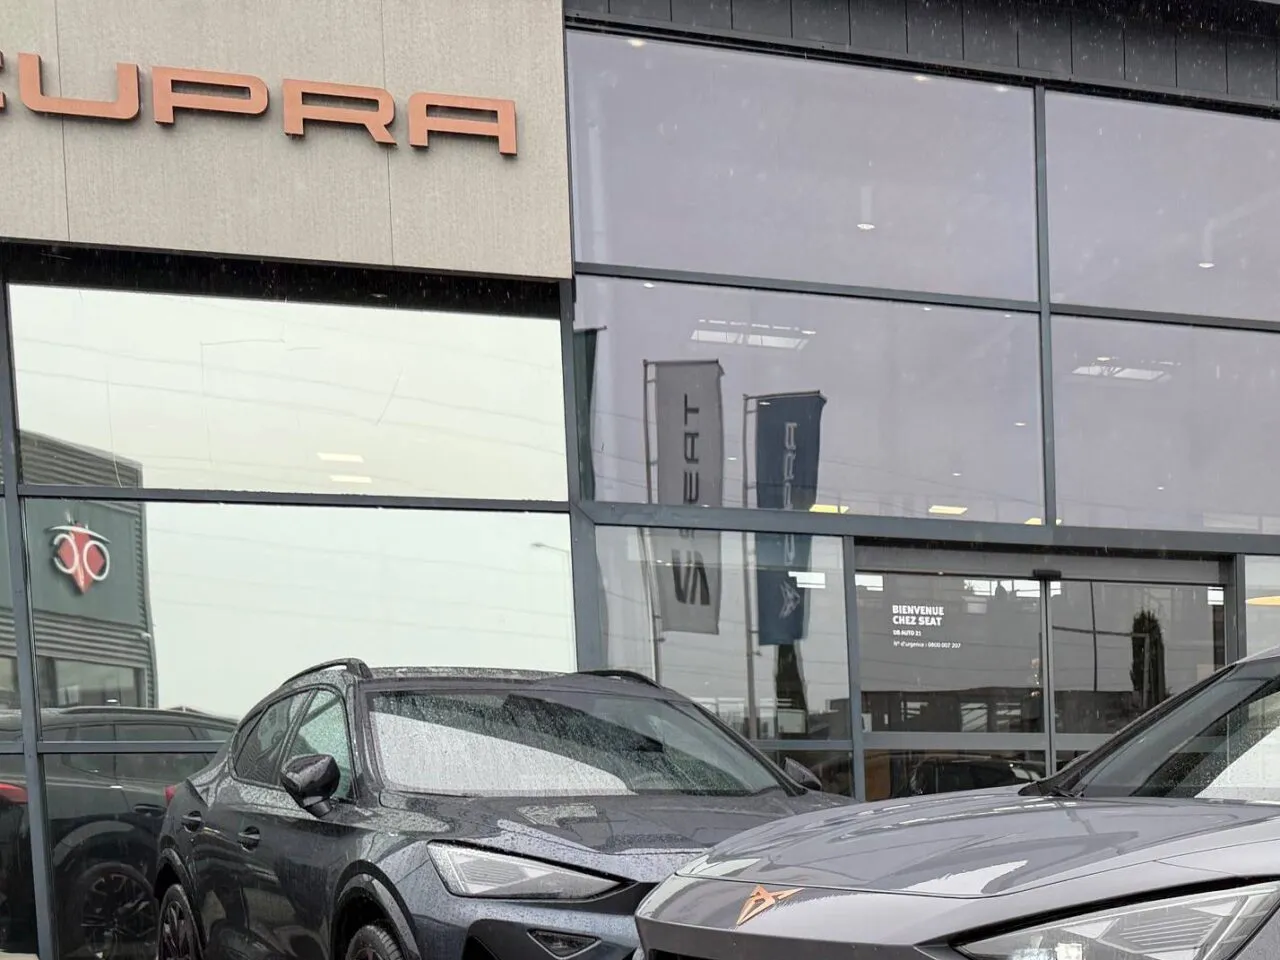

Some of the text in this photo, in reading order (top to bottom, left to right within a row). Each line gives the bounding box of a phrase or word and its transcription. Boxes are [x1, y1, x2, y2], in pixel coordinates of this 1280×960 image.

[0, 52, 517, 155] UPRA
[679, 394, 699, 539] EAT
[783, 422, 798, 566] CPRA
[892, 605, 945, 616] BIENVENUE
[892, 615, 943, 626] CHEZ SEAT
